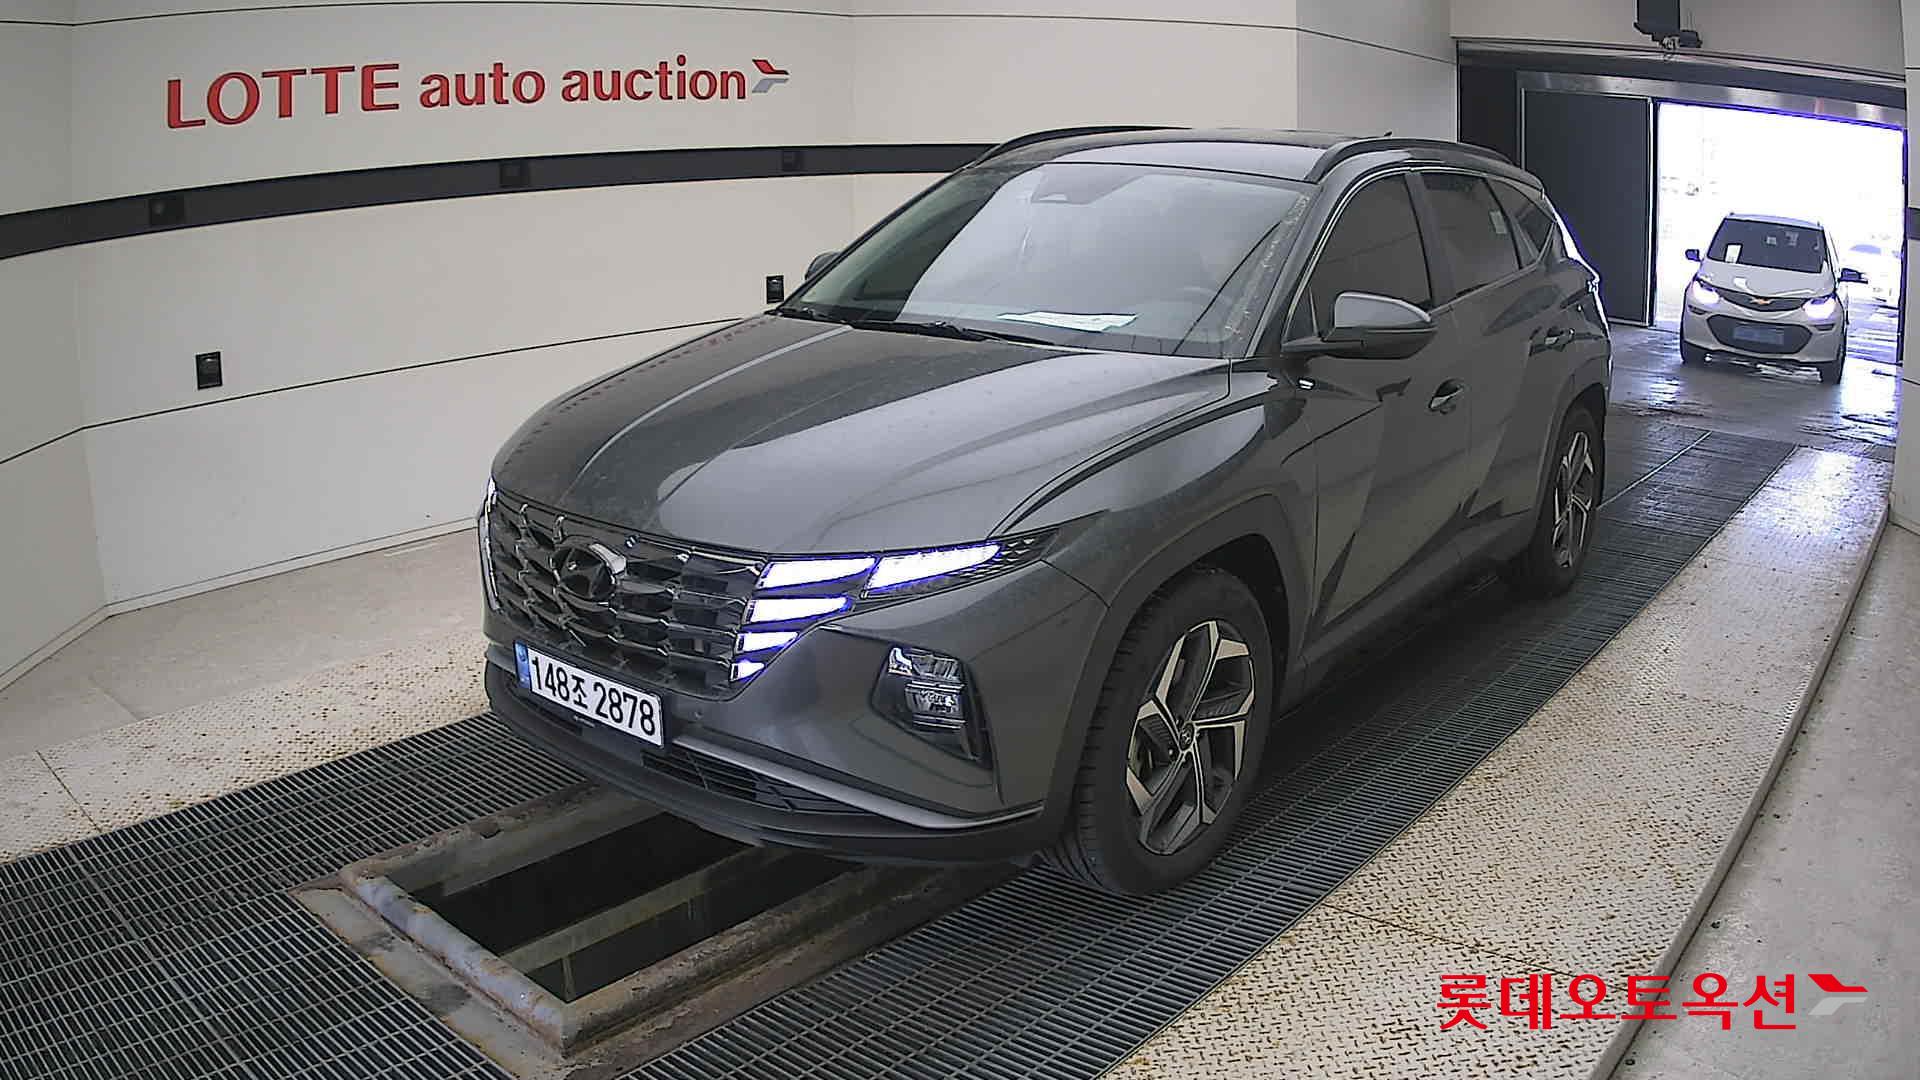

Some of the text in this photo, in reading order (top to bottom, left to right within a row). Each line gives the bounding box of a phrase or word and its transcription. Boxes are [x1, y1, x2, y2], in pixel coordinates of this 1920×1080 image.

[167, 55, 747, 129] LOTTE auto auction
[531, 656, 656, 736] 148조 2878
